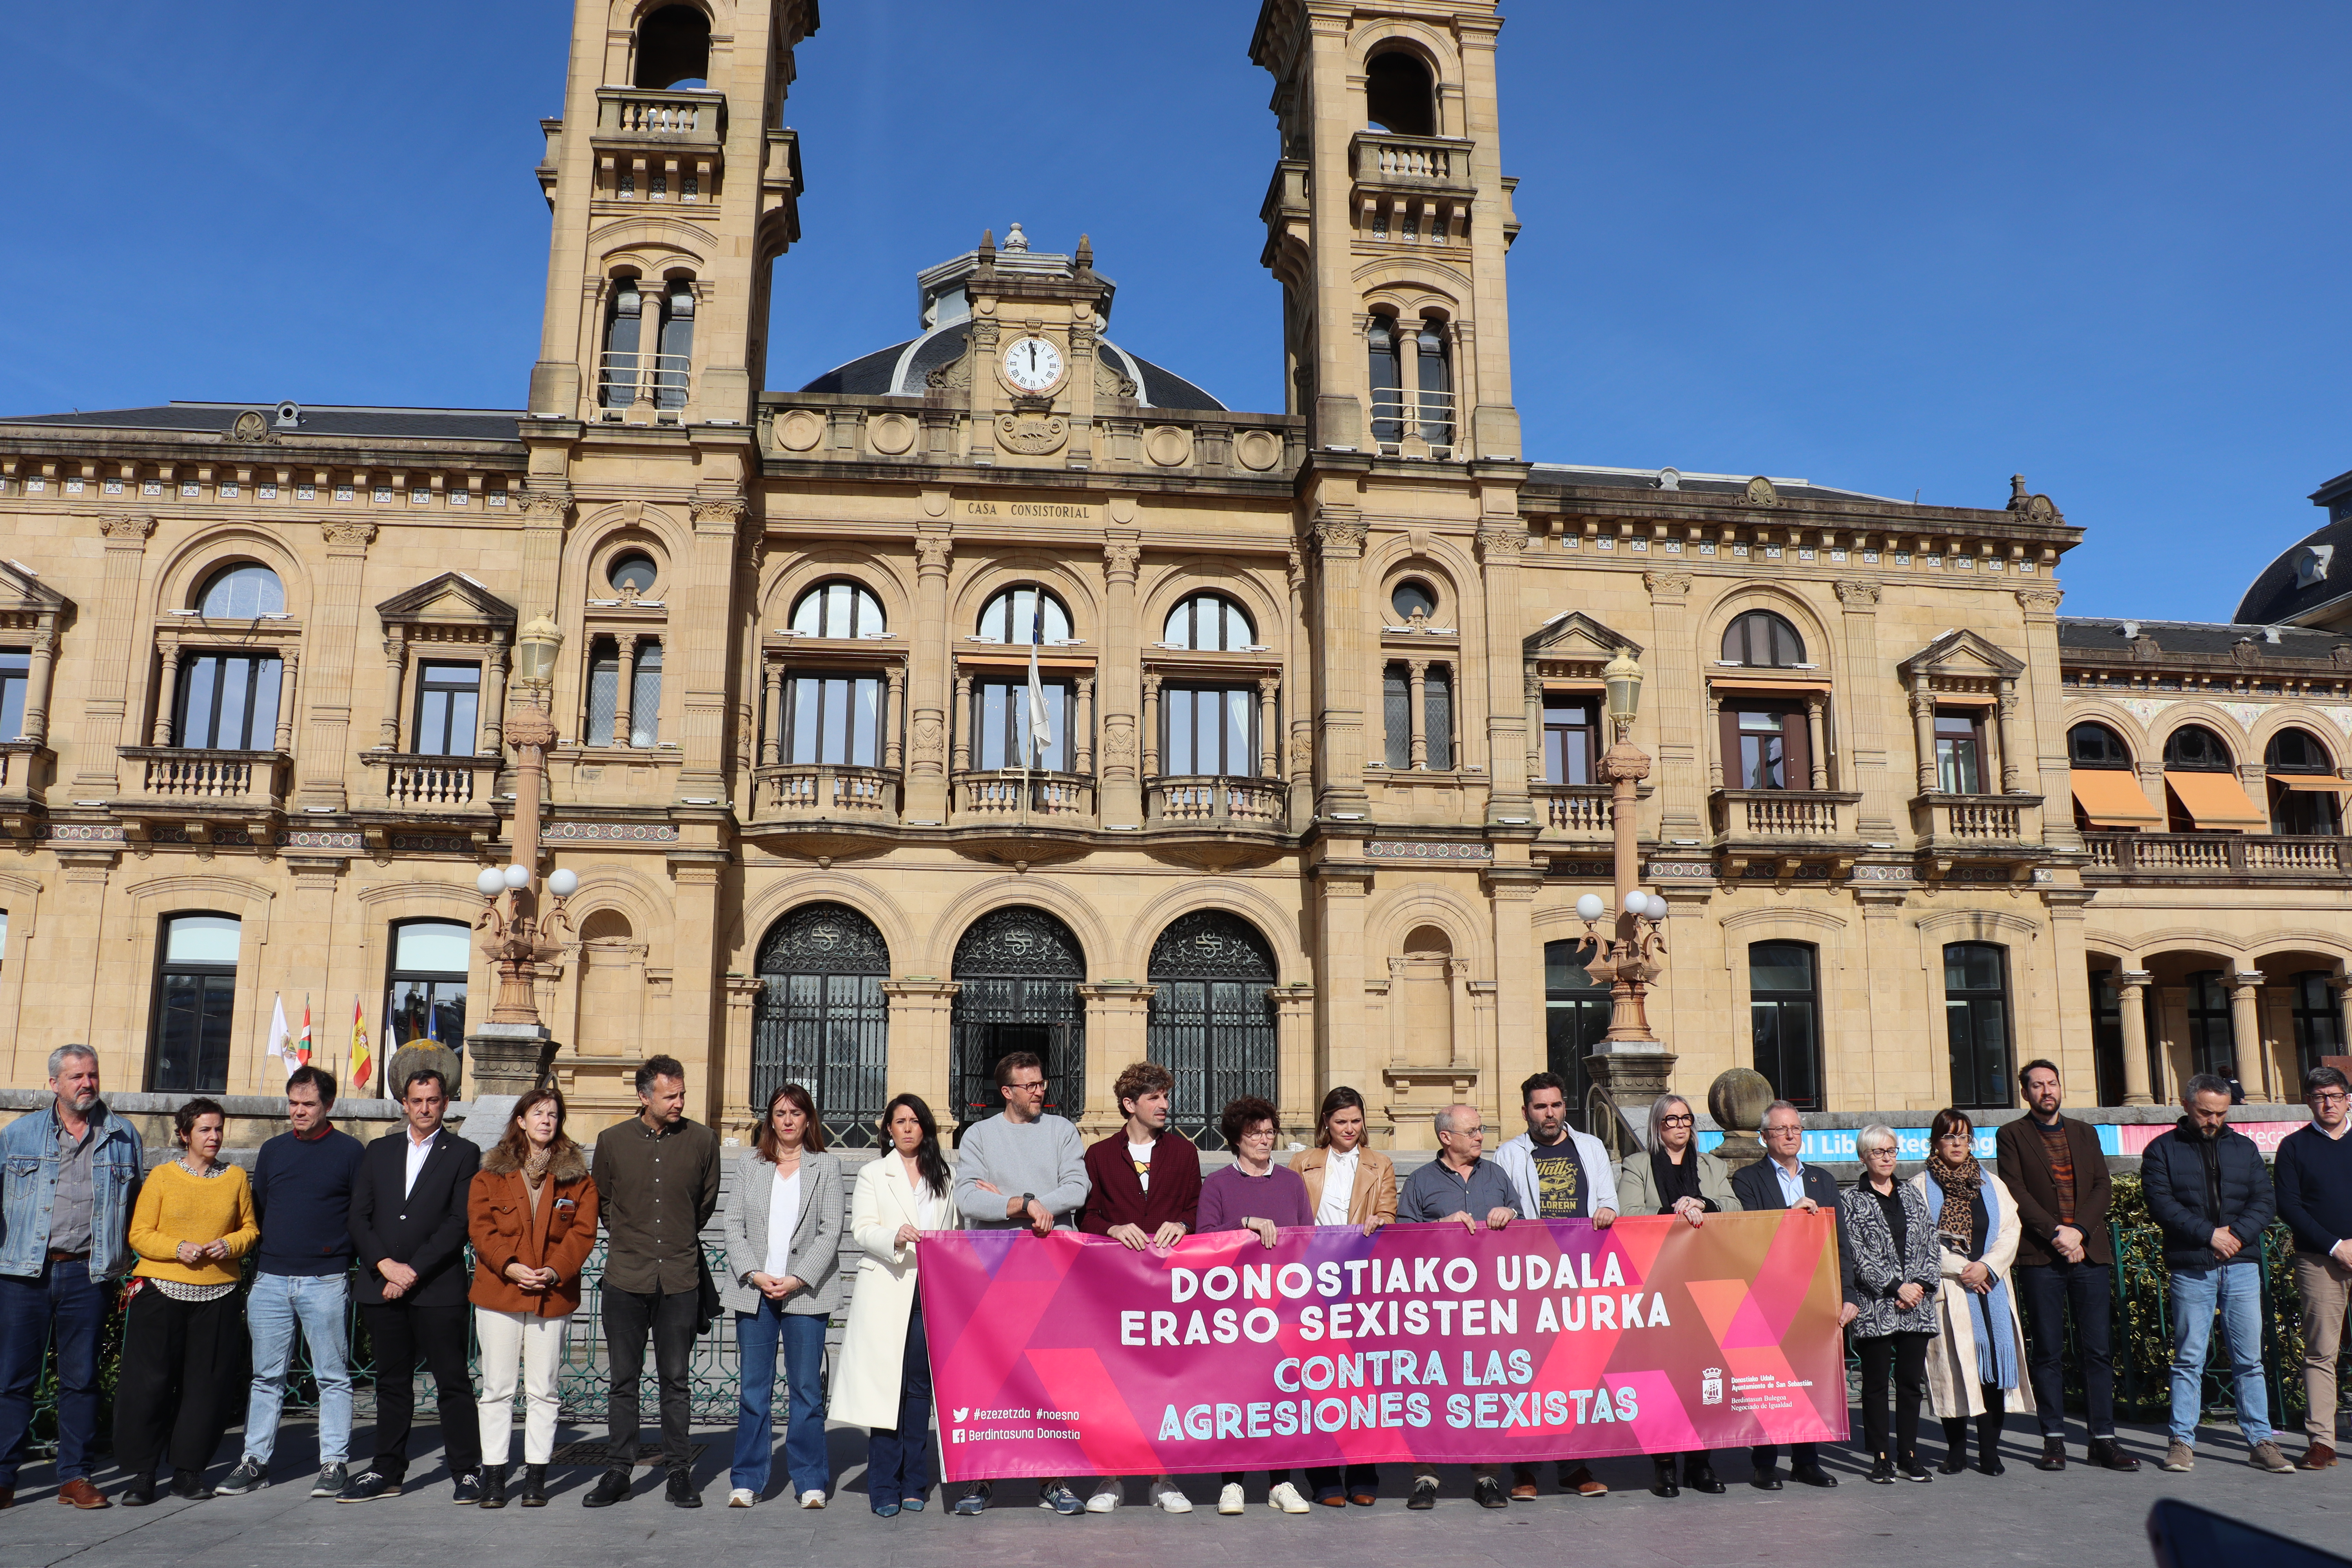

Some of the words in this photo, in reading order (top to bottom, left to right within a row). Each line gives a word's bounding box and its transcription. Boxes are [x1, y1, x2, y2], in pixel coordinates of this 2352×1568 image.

[968, 503, 997, 515] CASA
[1011, 505, 1089, 518] CONSISTORIAL
[1540, 1201, 1576, 1209] LOREAN
[1171, 1257, 1478, 1303] DONOSTIAKO
[1497, 1251, 1626, 1291] UDALA
[1120, 1307, 1280, 1346] ERASO
[1299, 1298, 1518, 1341] SEXISTEN
[1535, 1291, 1671, 1334] AURKA
[1273, 1349, 1449, 1393] CONTRA
[1463, 1348, 1533, 1386] LAS
[1731, 1383, 1766, 1392] Ayuntamiento
[1158, 1392, 1432, 1441] AGRESIONES
[1445, 1386, 1639, 1429] SEXISTAS
[1731, 1403, 1759, 1412] Negociado
[1769, 1401, 1792, 1410] Igualdad
[974, 1407, 1030, 1421] #ezezetzda
[1036, 1408, 1079, 1420] #noesno
[969, 1428, 1034, 1441] Berdintasuna
[1037, 1428, 1080, 1439] Donostia
